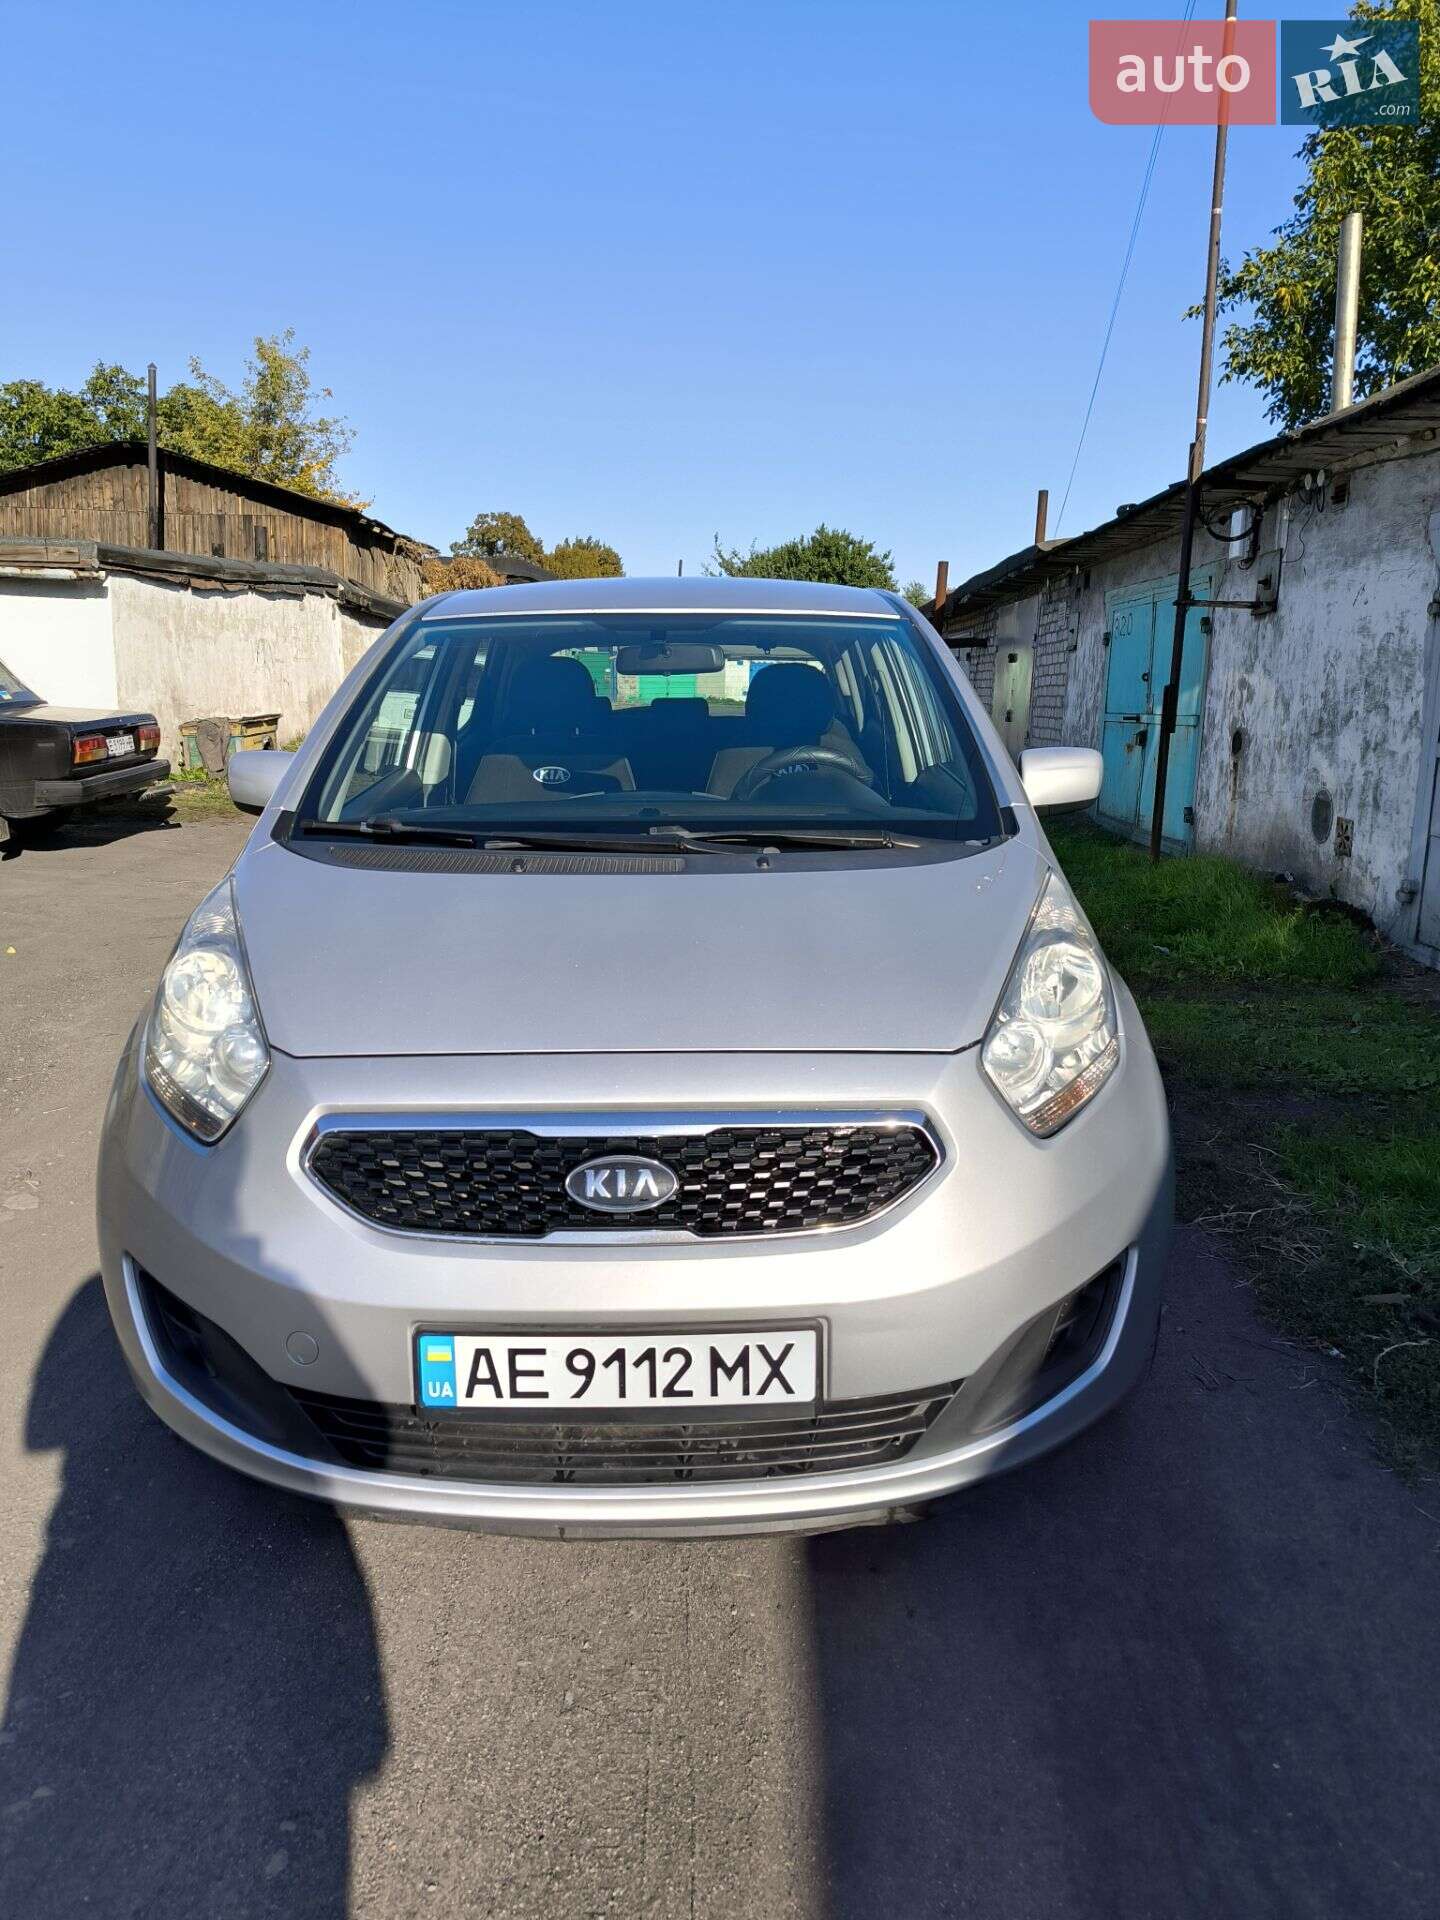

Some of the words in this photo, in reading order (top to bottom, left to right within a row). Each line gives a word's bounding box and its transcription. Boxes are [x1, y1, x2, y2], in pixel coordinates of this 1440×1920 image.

[540, 769, 565, 780] KIA
[585, 1168, 659, 1199] KIA
[465, 1348, 549, 1399] AE
[565, 1346, 694, 1399] 9112
[710, 1343, 796, 1397] MX
[428, 1381, 454, 1398] UA
